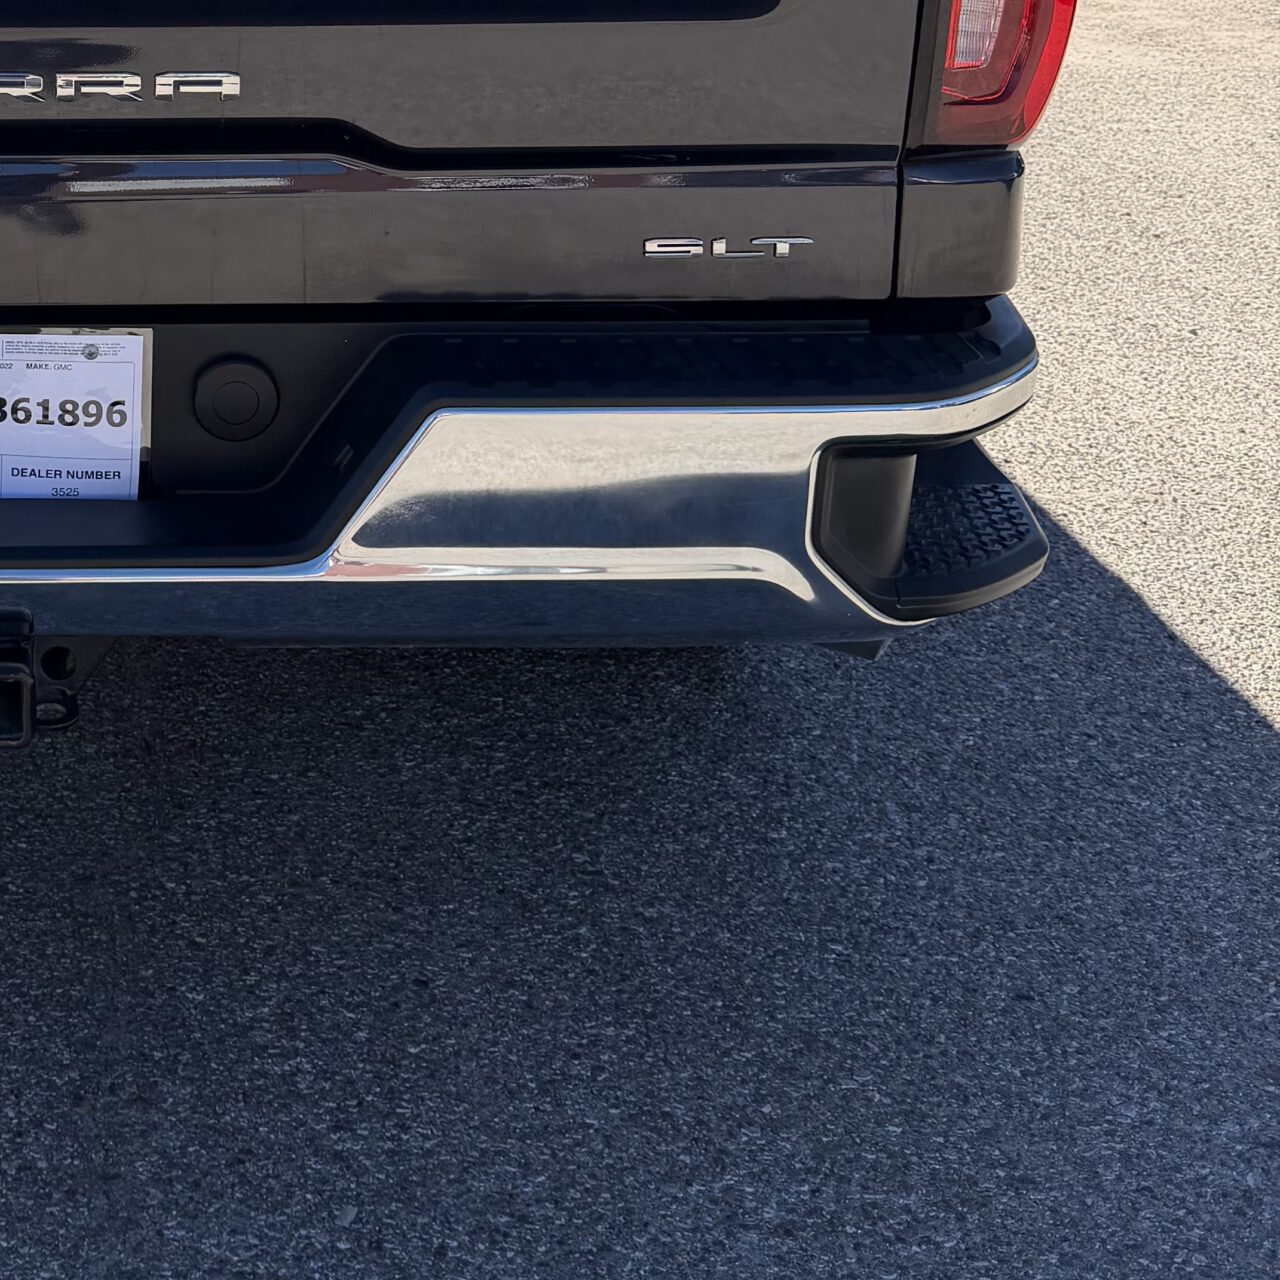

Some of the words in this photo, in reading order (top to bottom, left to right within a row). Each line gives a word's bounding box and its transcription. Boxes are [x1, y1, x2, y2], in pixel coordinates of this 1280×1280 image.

[643, 236, 814, 258] SLT
[53, 363, 73, 371] GMC
[11, 467, 63, 480] DEALER
[66, 469, 122, 480] NUMBER
[51, 487, 80, 497] 3525
